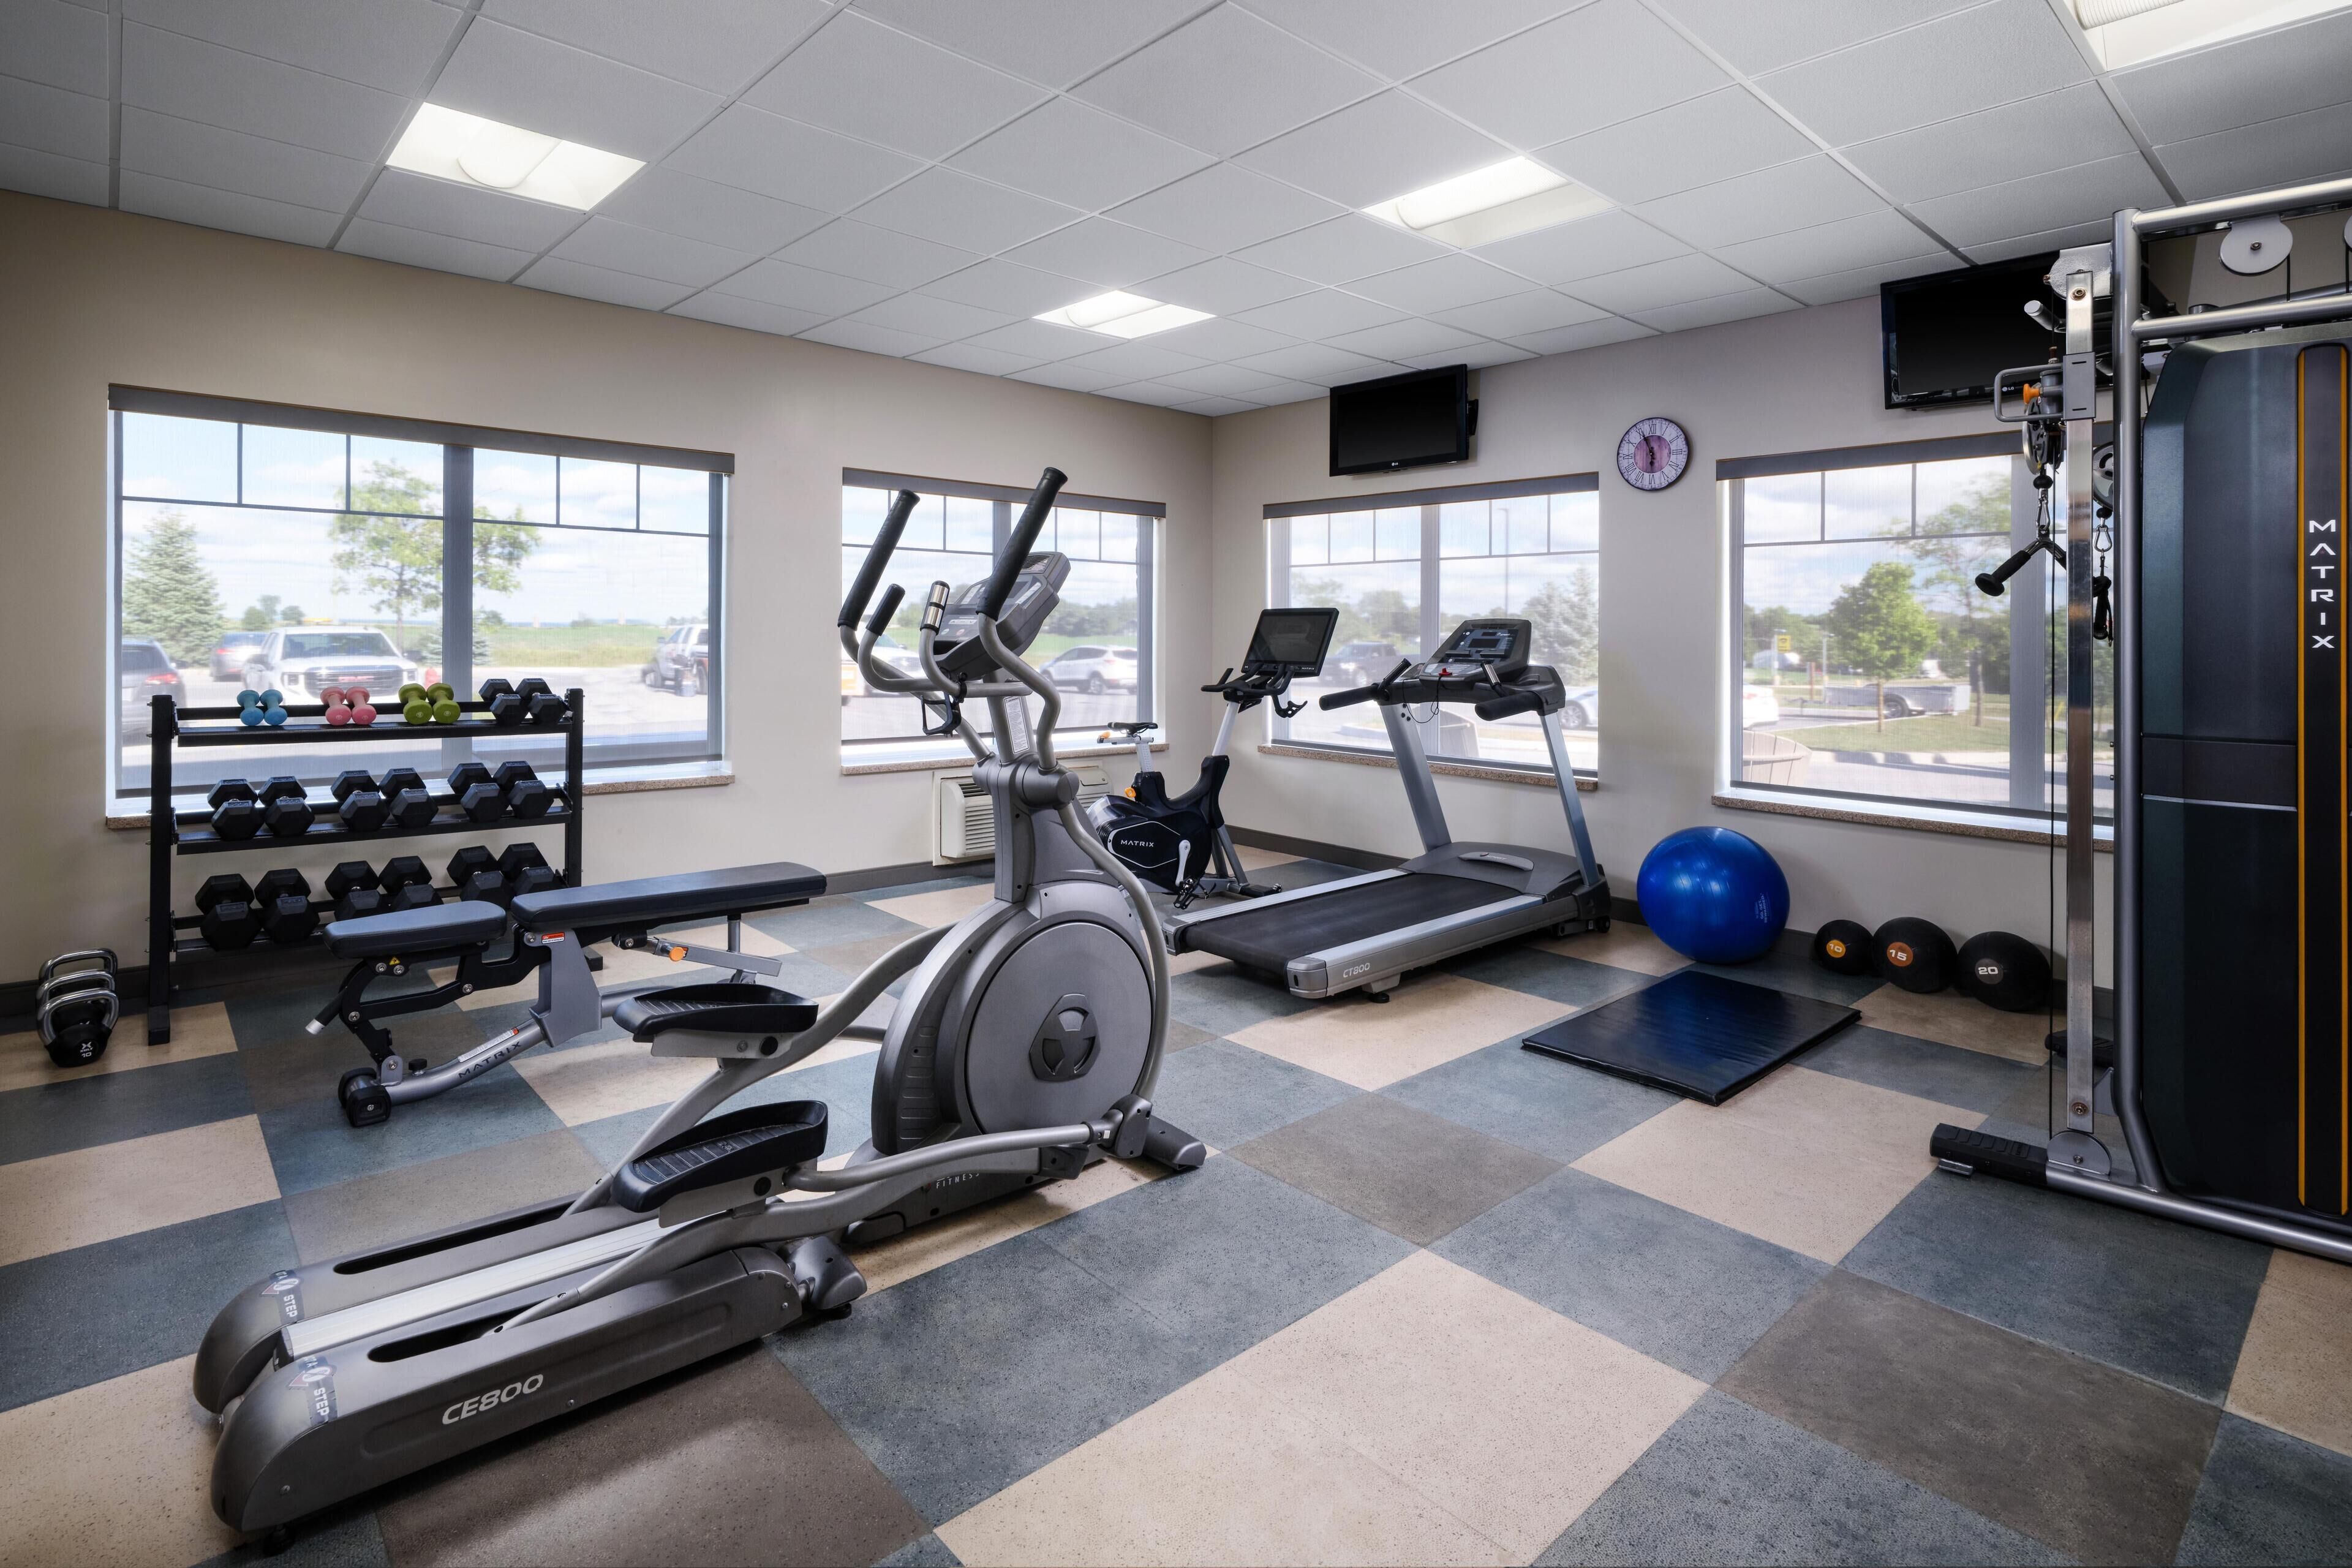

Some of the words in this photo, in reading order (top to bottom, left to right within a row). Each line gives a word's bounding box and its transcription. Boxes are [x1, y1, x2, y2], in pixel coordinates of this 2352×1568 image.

[1625, 462, 1637, 475] VIII
[1668, 461, 1679, 471] IV
[1635, 471, 1644, 483] VII
[1649, 474, 1656, 484] VI
[1661, 470, 1669, 481] V
[2309, 519, 2335, 648] MATRIX
[1829, 943, 1842, 953] 10
[1889, 949, 1907, 962] 15
[1343, 962, 1370, 978] CT800
[1978, 967, 1999, 975] 20
[458, 1041, 521, 1078] MATRIX
[284, 1294, 298, 1317] STEP
[314, 1387, 330, 1416] STEP
[442, 1374, 543, 1425] CE800
